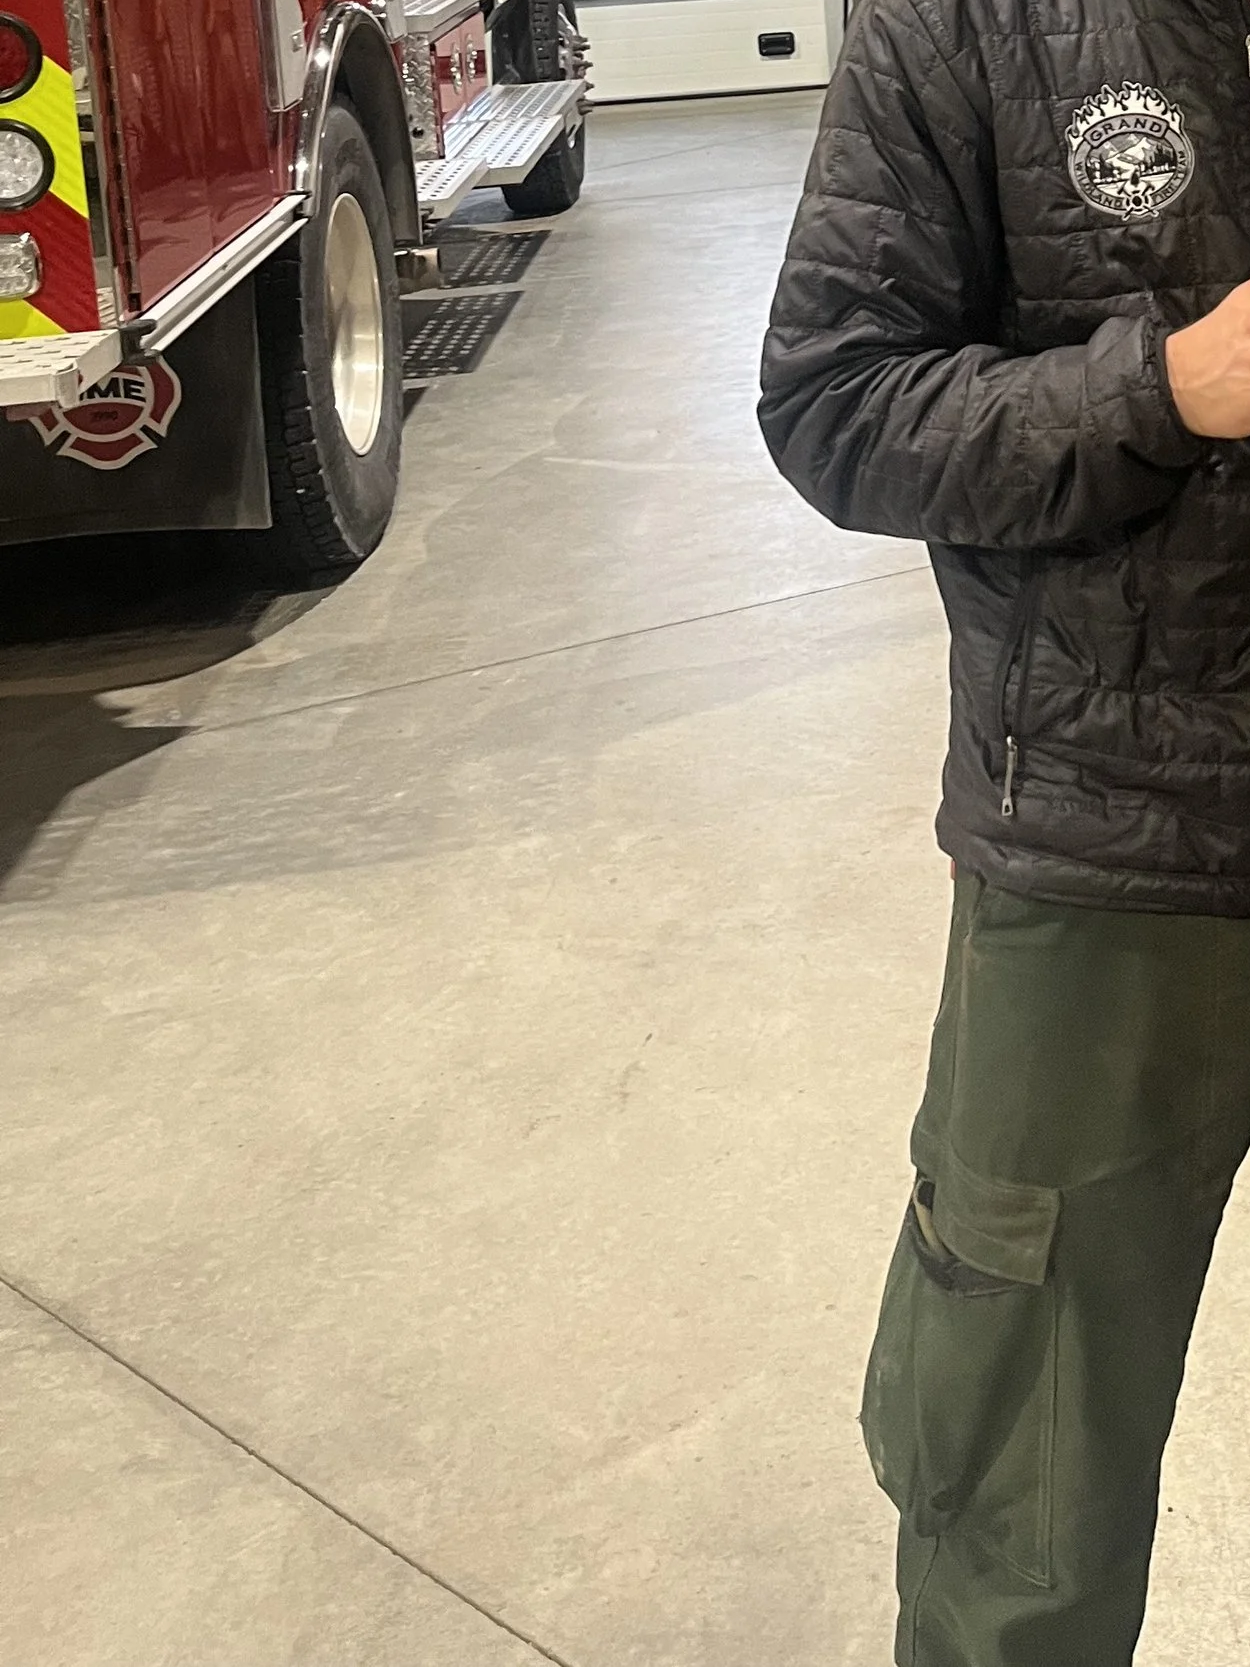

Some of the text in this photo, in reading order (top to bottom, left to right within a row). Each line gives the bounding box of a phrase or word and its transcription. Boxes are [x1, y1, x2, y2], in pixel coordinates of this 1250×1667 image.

[1089, 117, 1162, 142] GRAND
[1074, 161, 1123, 208] WILDLAND
[1152, 184, 1176, 205] FIRE
[79, 377, 147, 402] ME
